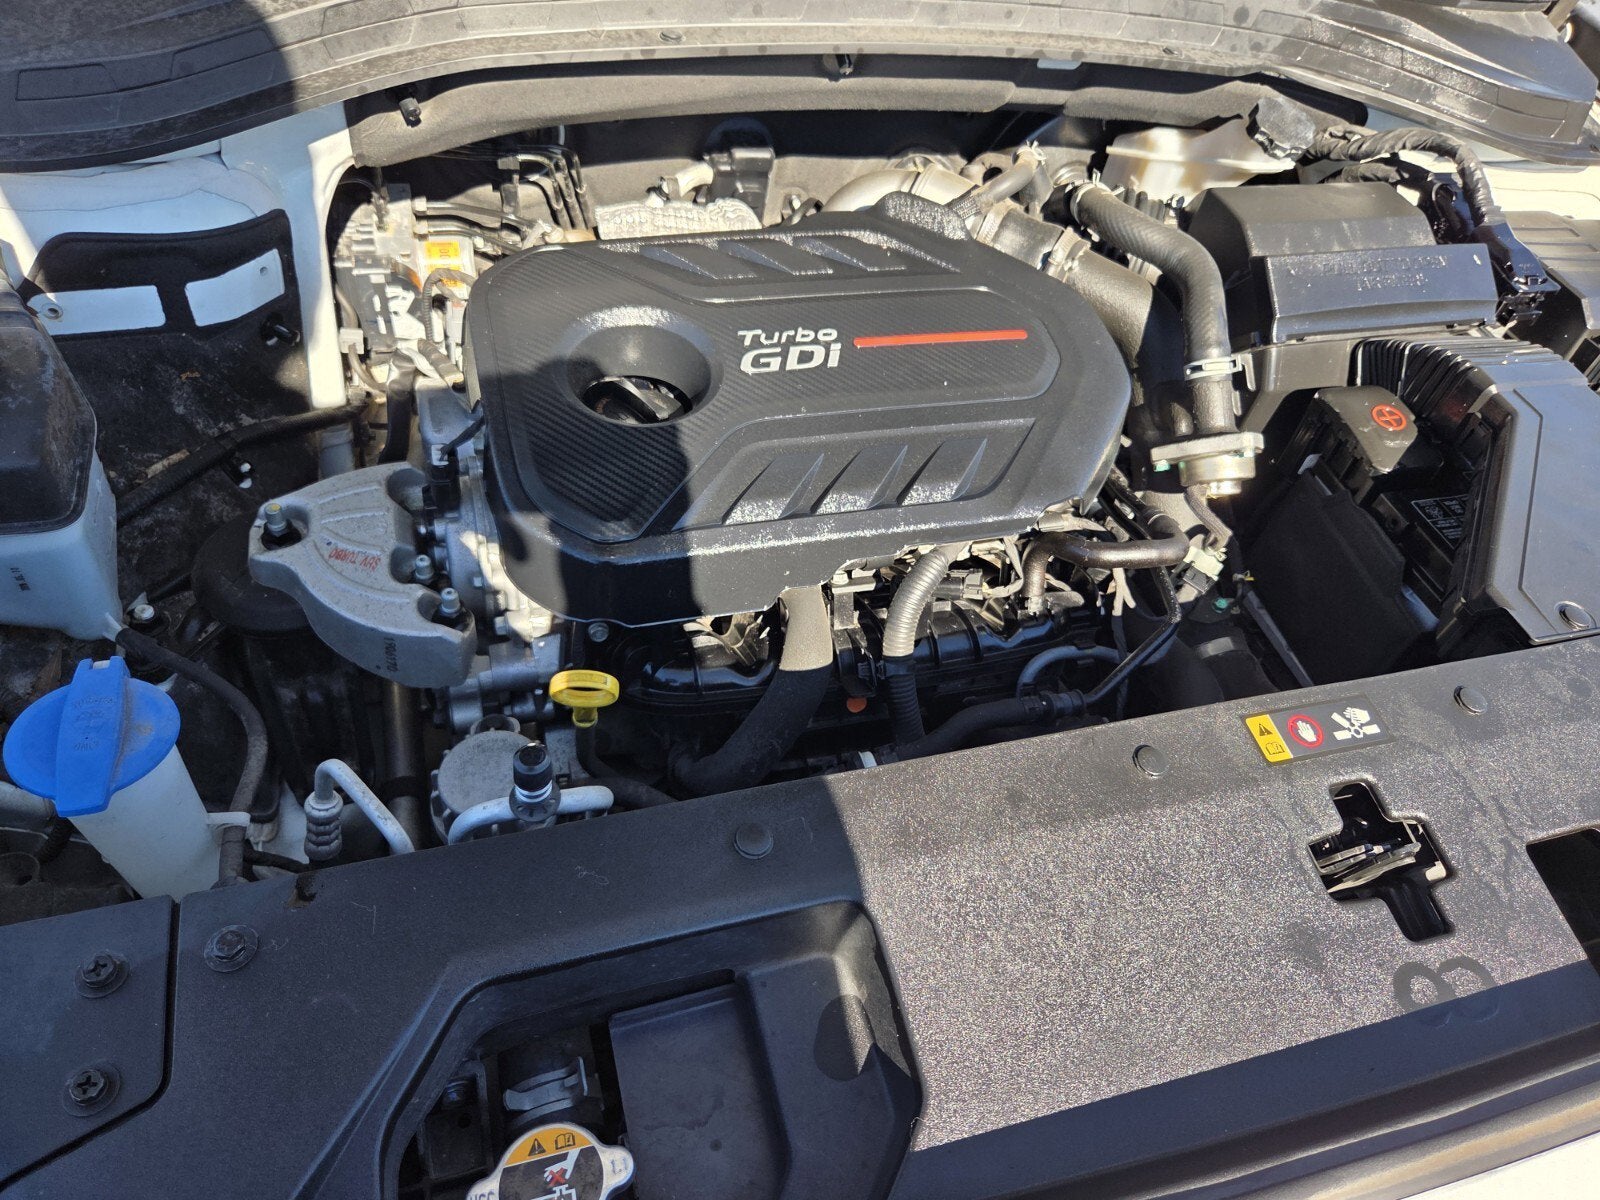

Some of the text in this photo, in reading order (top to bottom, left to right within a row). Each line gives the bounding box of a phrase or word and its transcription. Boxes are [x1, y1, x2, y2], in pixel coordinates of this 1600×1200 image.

[738, 327, 838, 347] Turbo
[740, 342, 842, 375] GDi
[329, 548, 381, 571] SUV TURBO
